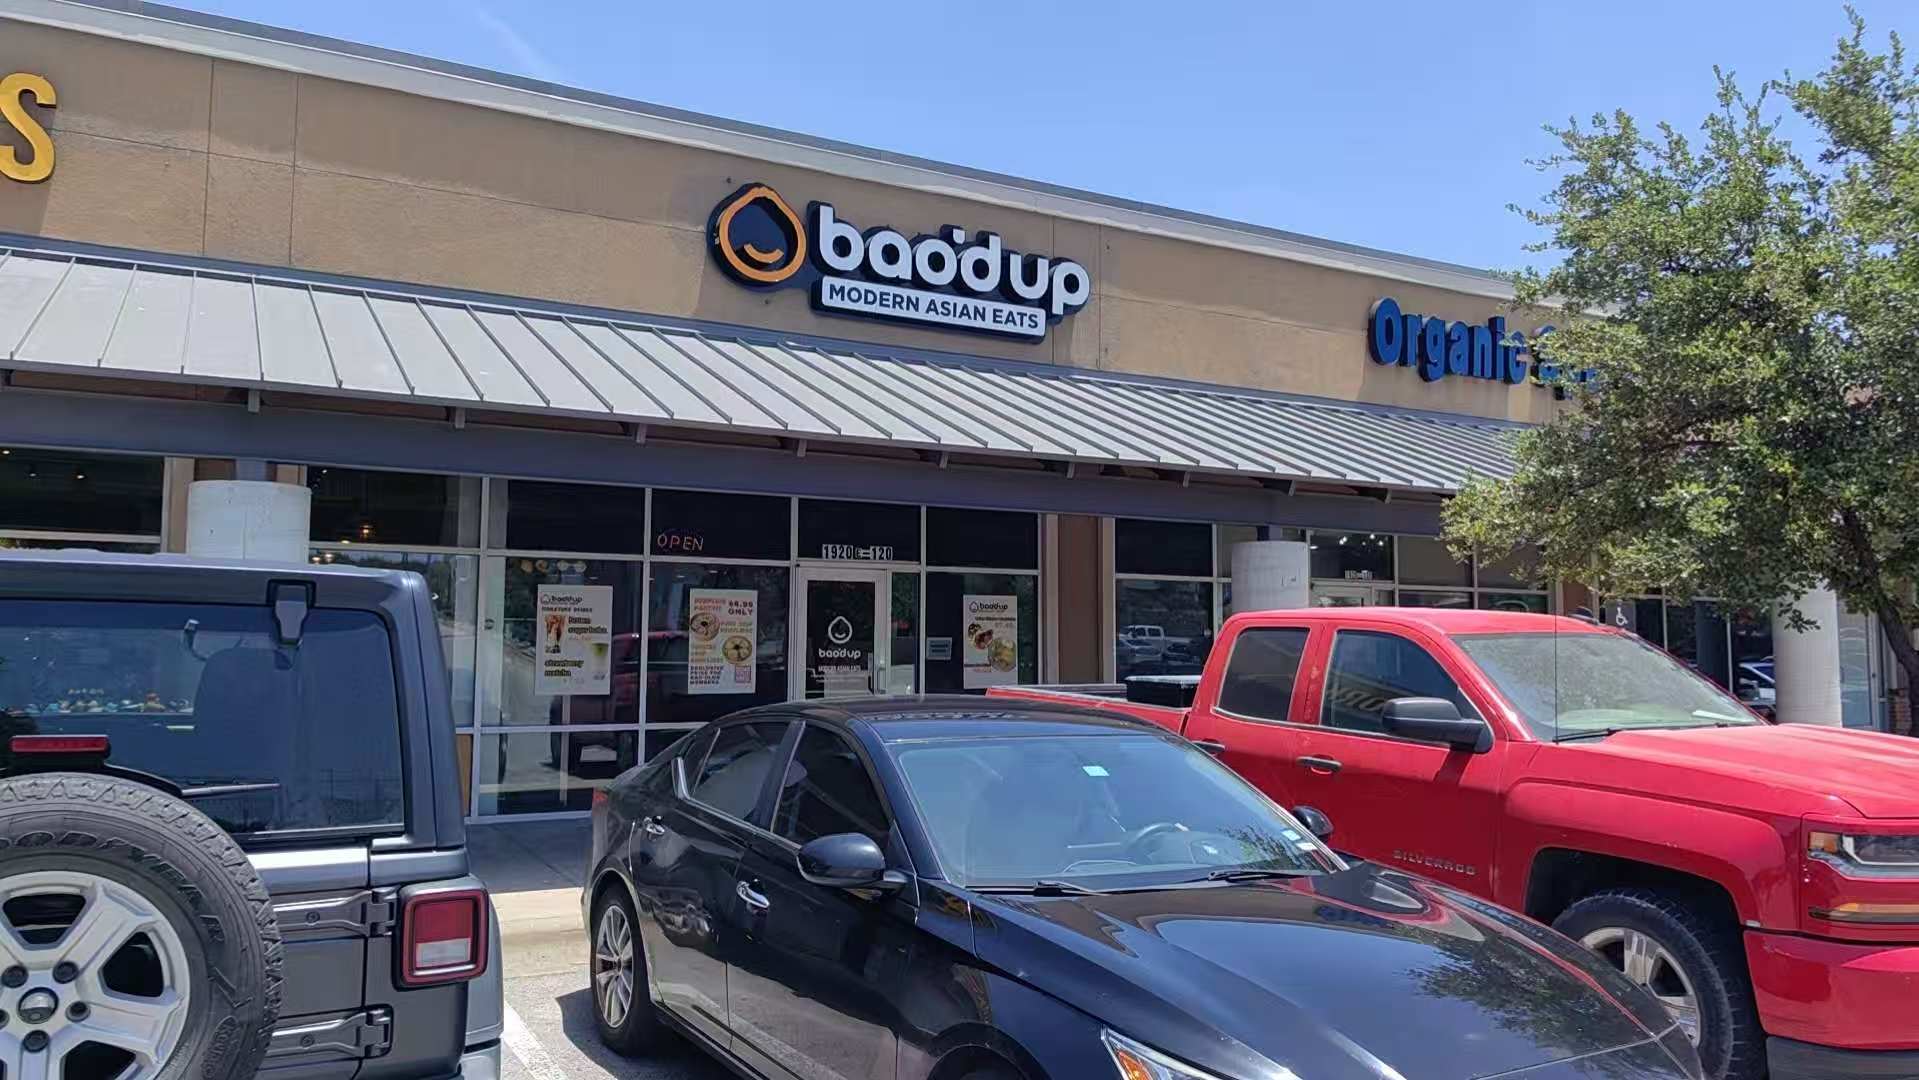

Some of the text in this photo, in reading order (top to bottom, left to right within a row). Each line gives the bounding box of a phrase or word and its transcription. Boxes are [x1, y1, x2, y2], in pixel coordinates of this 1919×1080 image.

[0, 72, 57, 183] S
[828, 282, 1039, 331] MODERN ASIAN EATS
[1367, 296, 1528, 385] Organic
[656, 533, 704, 551] OPEN
[727, 607, 754, 617] ONLY
[1392, 848, 1476, 876] SILVERADO
